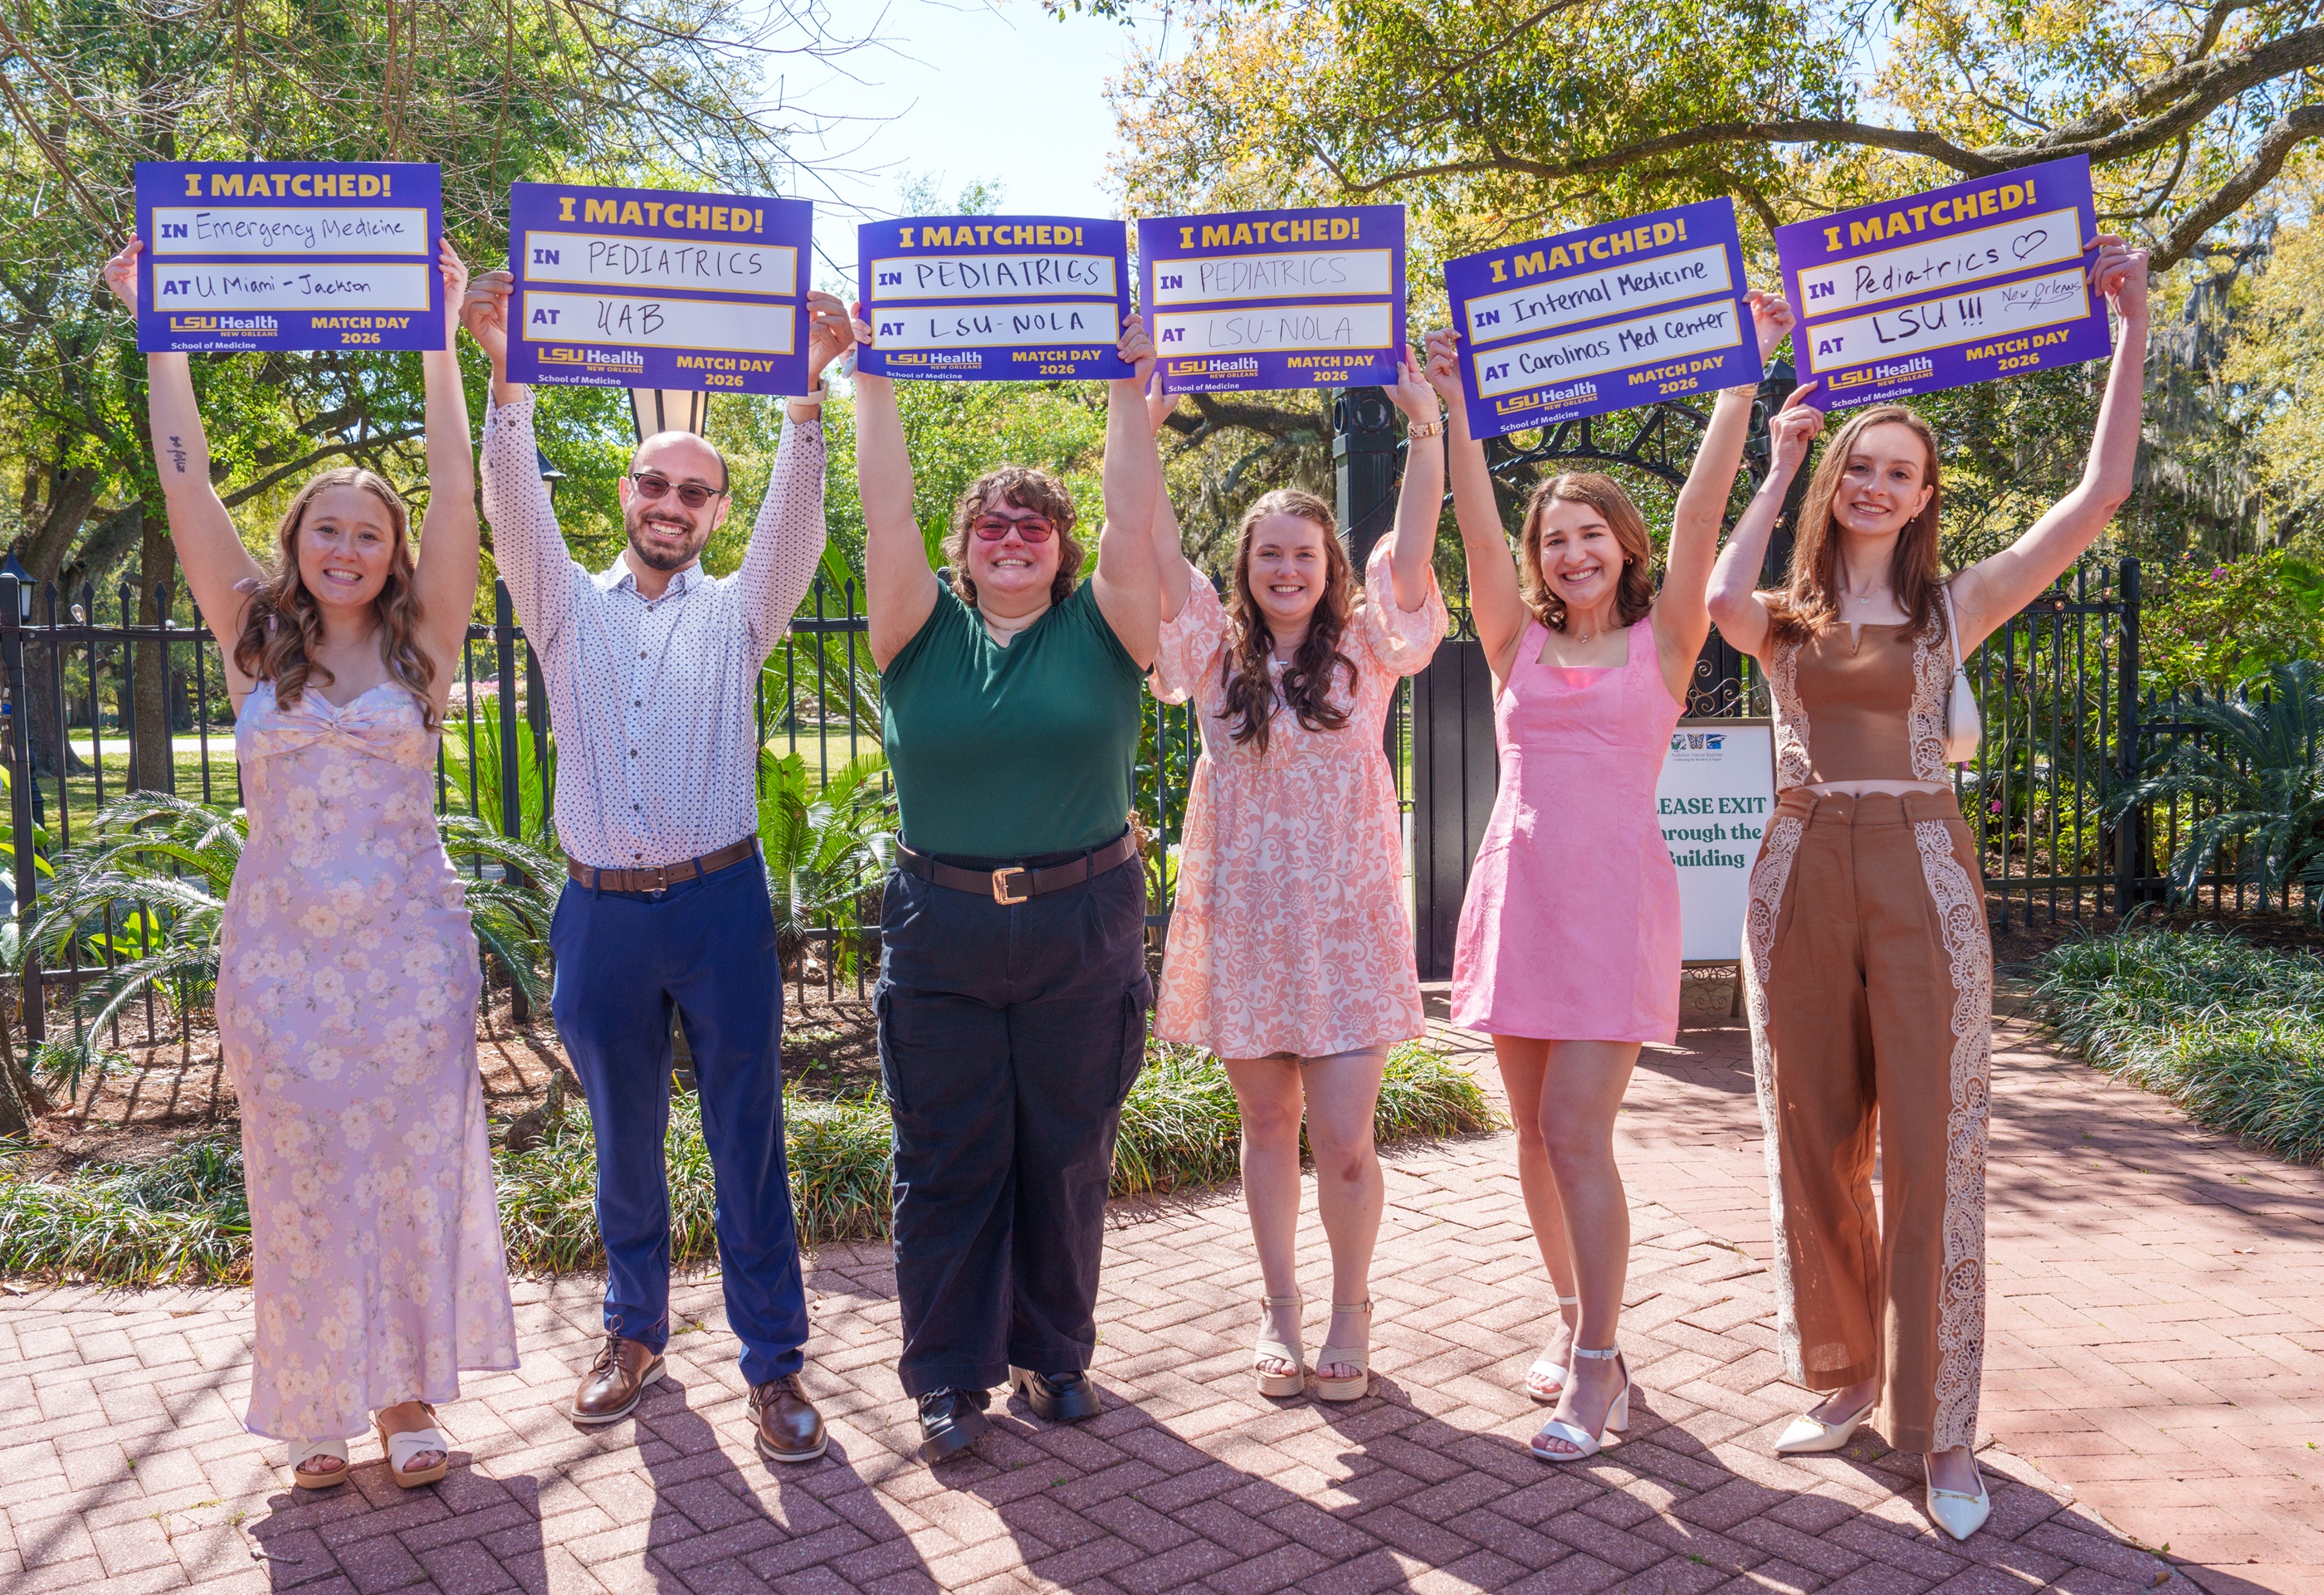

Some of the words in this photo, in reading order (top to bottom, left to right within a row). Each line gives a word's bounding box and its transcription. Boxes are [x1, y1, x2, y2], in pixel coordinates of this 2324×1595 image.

[185, 174, 201, 196] I
[211, 174, 391, 197] MATCHED!
[559, 197, 576, 222] I
[584, 198, 764, 233] MATCHED!
[1824, 226, 1843, 251] I
[1848, 179, 2037, 246] MATCHED!
[161, 224, 188, 238] IN
[196, 212, 314, 248] Emergency
[322, 217, 405, 238] Medicine
[900, 227, 914, 247] I
[922, 226, 1083, 246] MATCHED!
[1179, 227, 1194, 249] I
[1202, 217, 1360, 247] MATCHED!
[533, 249, 559, 265] IN
[588, 241, 762, 277] PEDIATRICS
[1489, 260, 1507, 283] I
[1514, 218, 1687, 277] MATCHED!
[879, 272, 902, 285] IN
[914, 258, 1100, 289] PEDIATRICS
[1160, 275, 1183, 290] IN
[1199, 257, 1347, 293] PEDIATRICS
[1809, 280, 1835, 300] IN
[1855, 248, 1999, 301] Pediatrics
[163, 280, 191, 295] AT
[196, 276, 215, 297] U
[224, 276, 276, 295] Miami
[299, 274, 371, 295] Jackson
[1475, 310, 1501, 328] IN
[1509, 278, 1610, 324] Internal
[1618, 261, 1708, 295] Medicine
[170, 316, 217, 329] LSU
[221, 315, 278, 329] Health
[311, 317, 373, 329] MATCH
[375, 317, 410, 329] DAY
[532, 310, 560, 324] AT
[880, 323, 905, 336] AT
[930, 311, 1085, 338] LSU-NOLA
[1819, 338, 1844, 356] AT
[1872, 302, 1946, 344] LSU
[2002, 290, 2029, 302] New
[341, 333, 381, 344] 2026
[1162, 328, 1185, 342] AT
[1208, 316, 1354, 348] LSU-NOLA
[1013, 350, 1067, 362] MATCH
[1071, 349, 1102, 360] DAY
[1485, 363, 1510, 382] AT
[1519, 340, 1609, 374] Carolinas
[1618, 326, 1659, 352] Med
[1664, 311, 1729, 339] Center
[1966, 338, 2029, 362] MATCH
[2032, 329, 2070, 349] DAY
[538, 348, 583, 363] LSU
[588, 350, 644, 365] Health
[676, 356, 736, 371] MATCH
[740, 359, 774, 373] DAY
[886, 354, 927, 363] LSU
[930, 352, 982, 363] Health
[1169, 360, 1207, 373] LSU
[1209, 357, 1258, 371] Health
[1287, 356, 1341, 368] MATCH
[1344, 355, 1374, 367] DAY
[1998, 354, 2040, 370] 2026
[538, 374, 569, 383] School
[571, 375, 580, 384] of
[581, 376, 622, 385] Medicine
[1039, 364, 1076, 374] 2026
[1313, 371, 1348, 382] 2026
[1628, 363, 1687, 386] MATCH
[1689, 355, 1724, 374] DAY
[1828, 368, 1872, 388] LSU
[1876, 357, 1933, 378] Health
[1897, 371, 1934, 383] ORLEANS
[705, 373, 744, 387] 2026
[1169, 384, 1194, 393] School
[1658, 379, 1698, 395] 2026
[1496, 393, 1540, 412] LSU
[1541, 382, 1597, 403] Health
[1564, 396, 1598, 407] ORLEANS
[1831, 397, 1862, 408] School
[1863, 393, 1872, 402] of
[1872, 387, 1913, 400] Medicine
[1500, 422, 1529, 432] School
[1540, 411, 1579, 425] Medicine
[1657, 798, 1714, 814] EASE
[1718, 797, 1766, 813] EXIT
[1731, 822, 1762, 840] the
